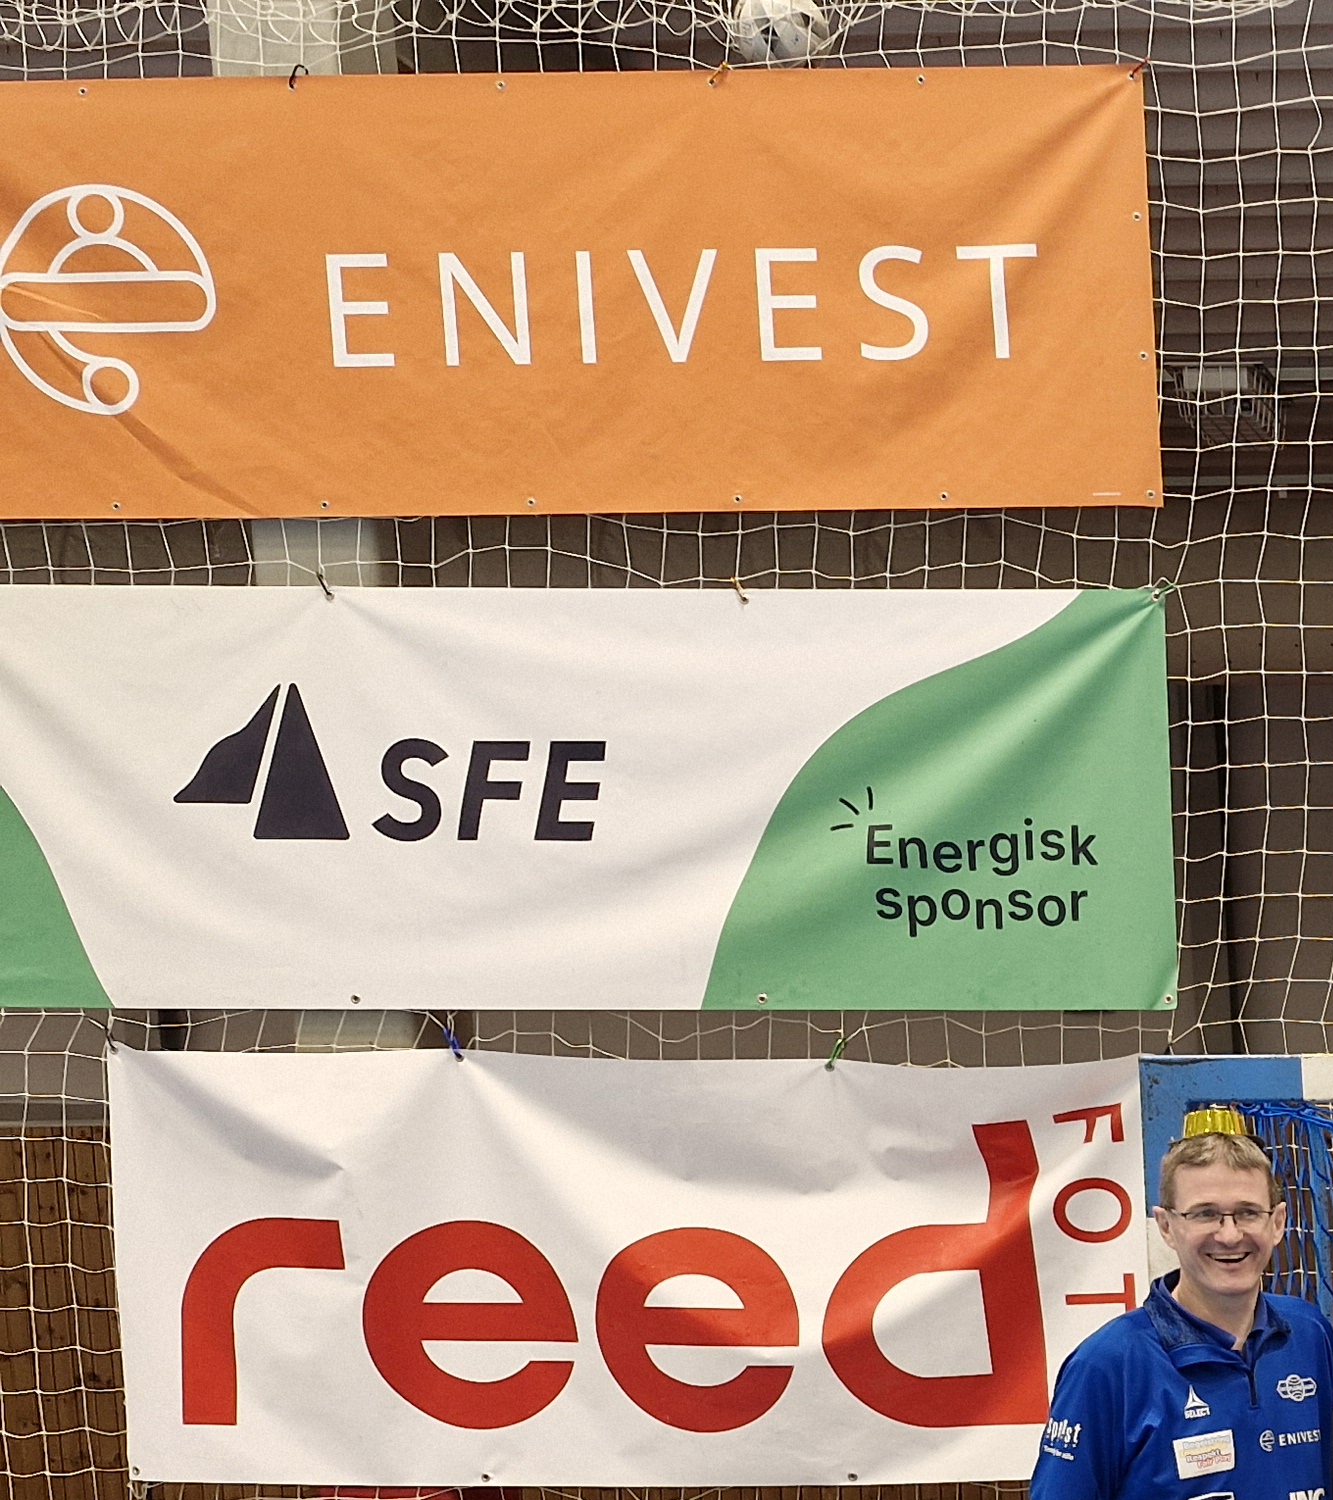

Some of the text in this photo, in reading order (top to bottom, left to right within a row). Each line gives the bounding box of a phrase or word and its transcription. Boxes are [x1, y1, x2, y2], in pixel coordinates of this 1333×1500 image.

[325, 243, 1037, 368] ENIVEST
[371, 738, 607, 842] SFE
[865, 817, 1099, 877] Energisk
[875, 881, 1088, 938] sponsor
[181, 1119, 1049, 1432] reed
[1184, 1407, 1210, 1419] SELECT
